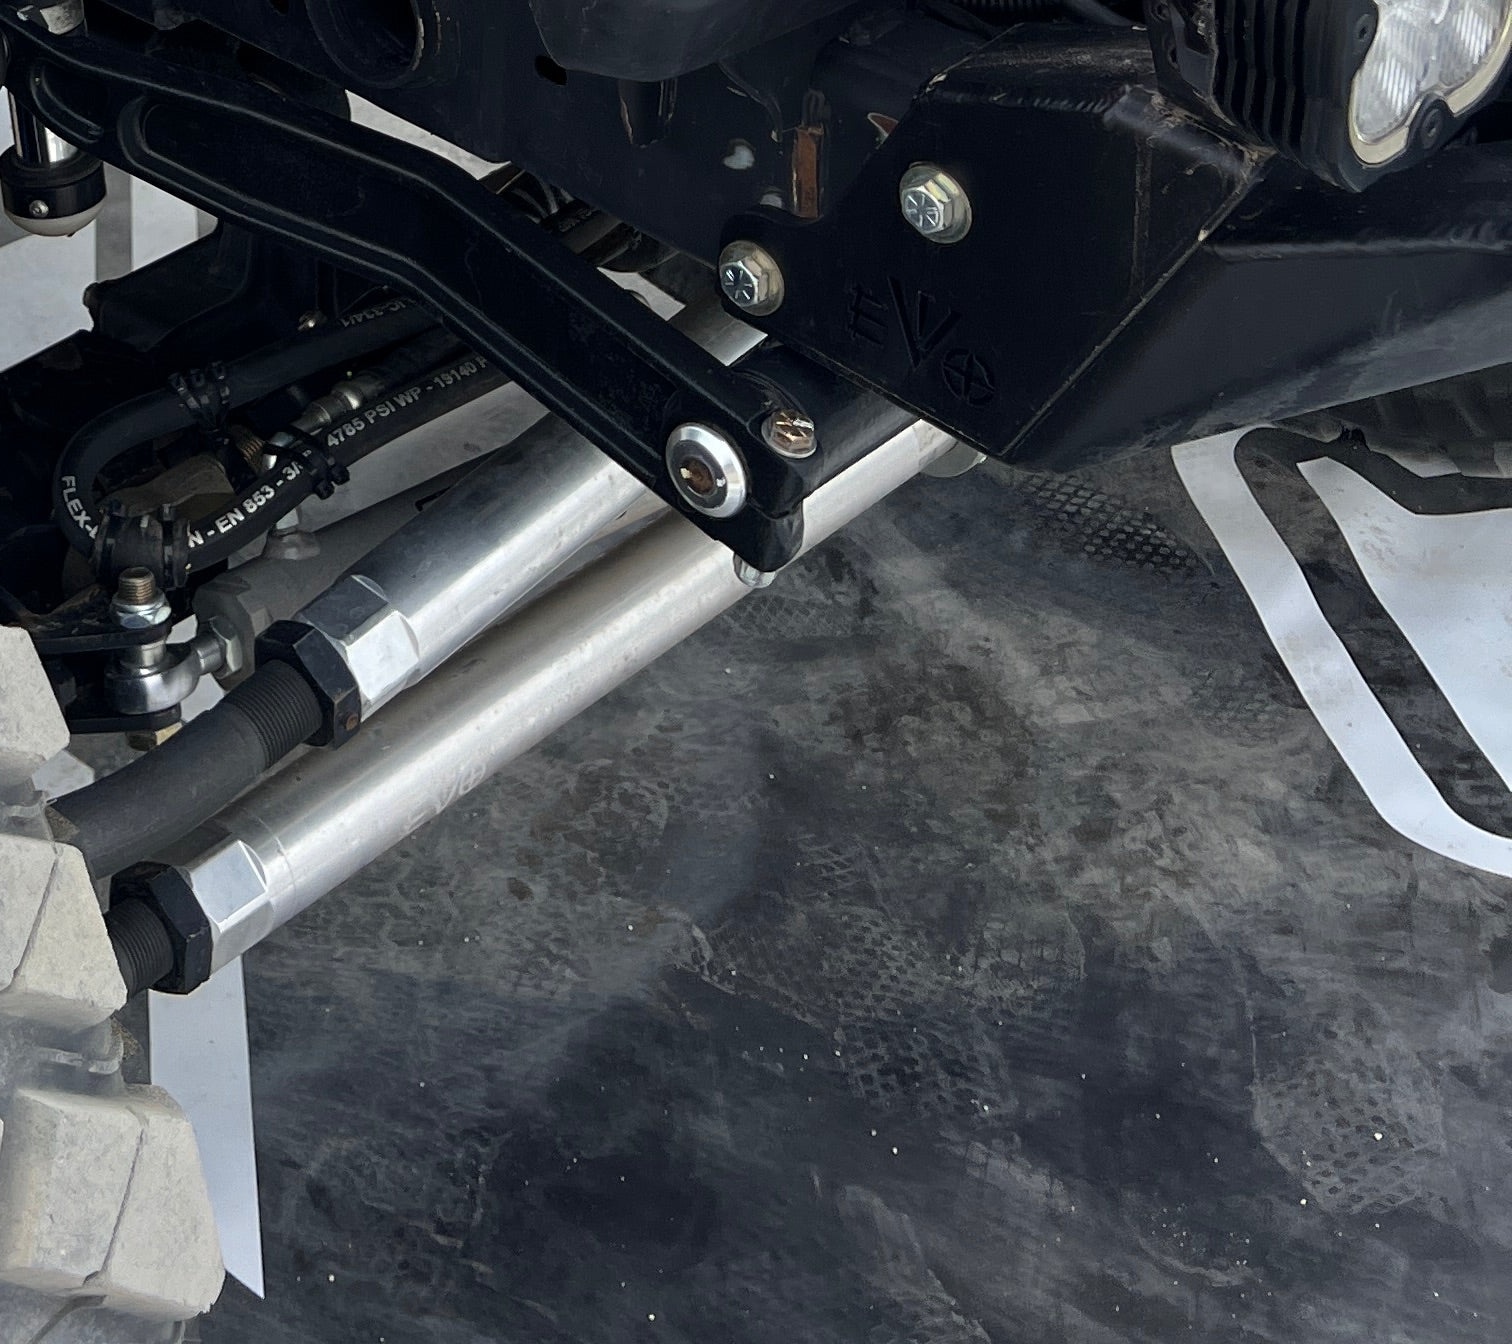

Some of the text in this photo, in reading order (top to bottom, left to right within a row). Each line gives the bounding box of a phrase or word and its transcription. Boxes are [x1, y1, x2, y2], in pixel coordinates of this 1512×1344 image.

[216, 505, 246, 534] EN
[242, 484, 275, 514] 853
[326, 416, 366, 448] 4785
[364, 402, 397, 425] PSI
[395, 386, 423, 408] WP
